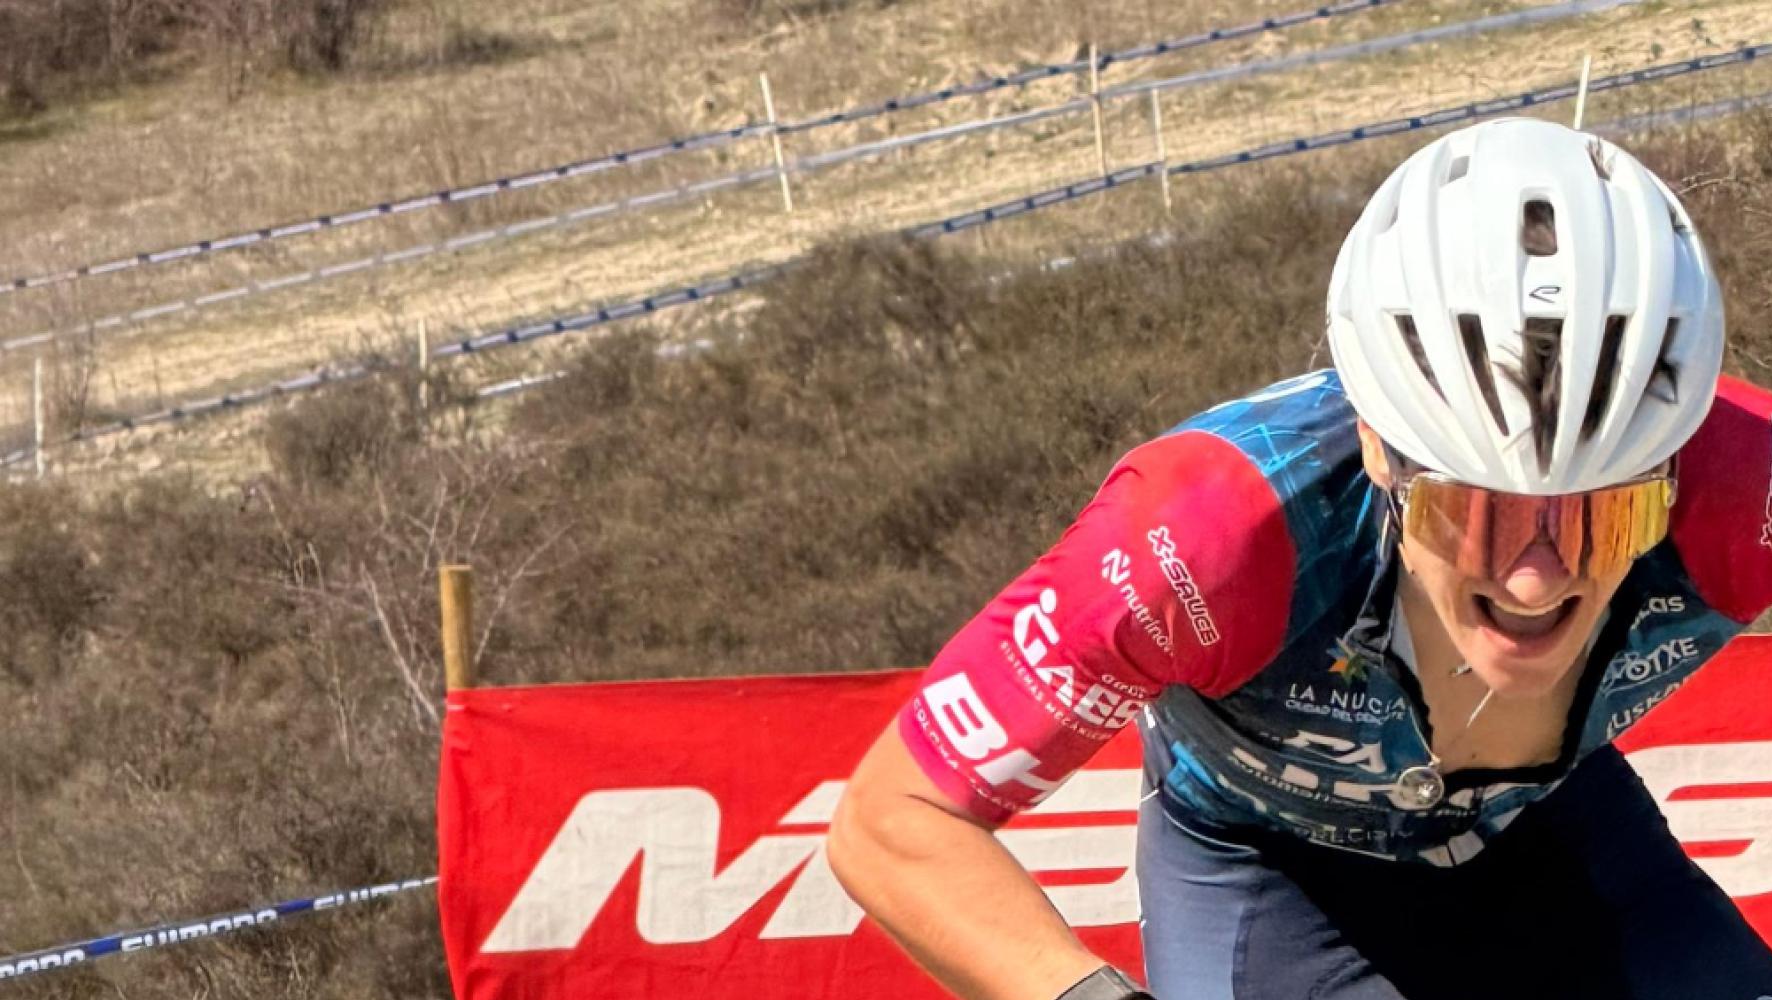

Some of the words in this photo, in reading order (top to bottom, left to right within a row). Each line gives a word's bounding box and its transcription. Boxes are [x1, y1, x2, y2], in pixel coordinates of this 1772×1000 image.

[1148, 525, 1220, 646] X-SAUCE
[923, 672, 1060, 808] BH
[1289, 683, 1315, 701] LA
